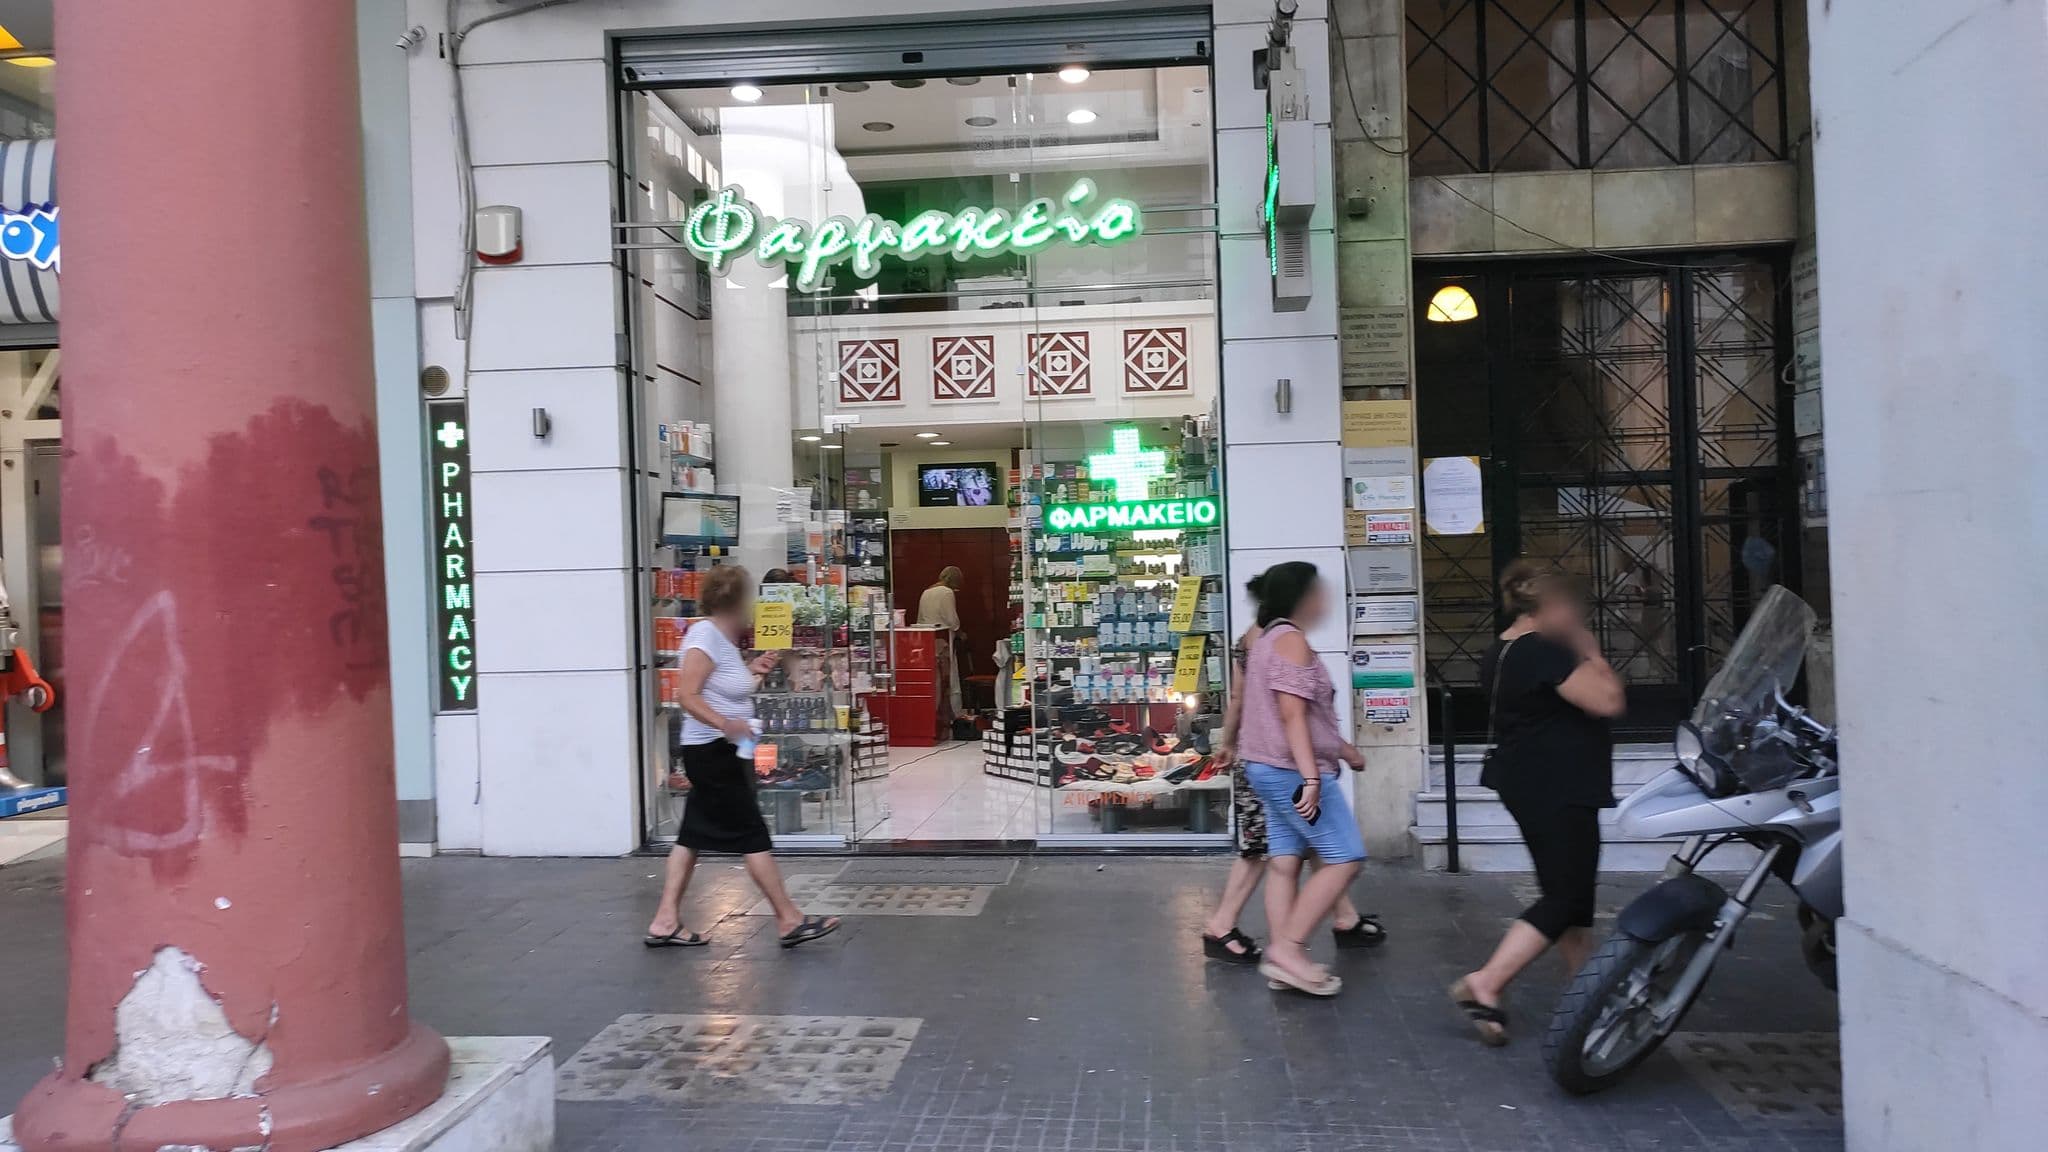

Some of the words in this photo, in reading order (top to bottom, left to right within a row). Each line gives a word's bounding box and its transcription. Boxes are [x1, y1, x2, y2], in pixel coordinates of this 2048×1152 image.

[685, 179, 1140, 288] Φαρμακείο
[1049, 501, 1216, 529] ΦΑΡΜΑΚΕΙΟ
[442, 462, 472, 701] PHARMACY
[756, 624, 791, 637] -25%
